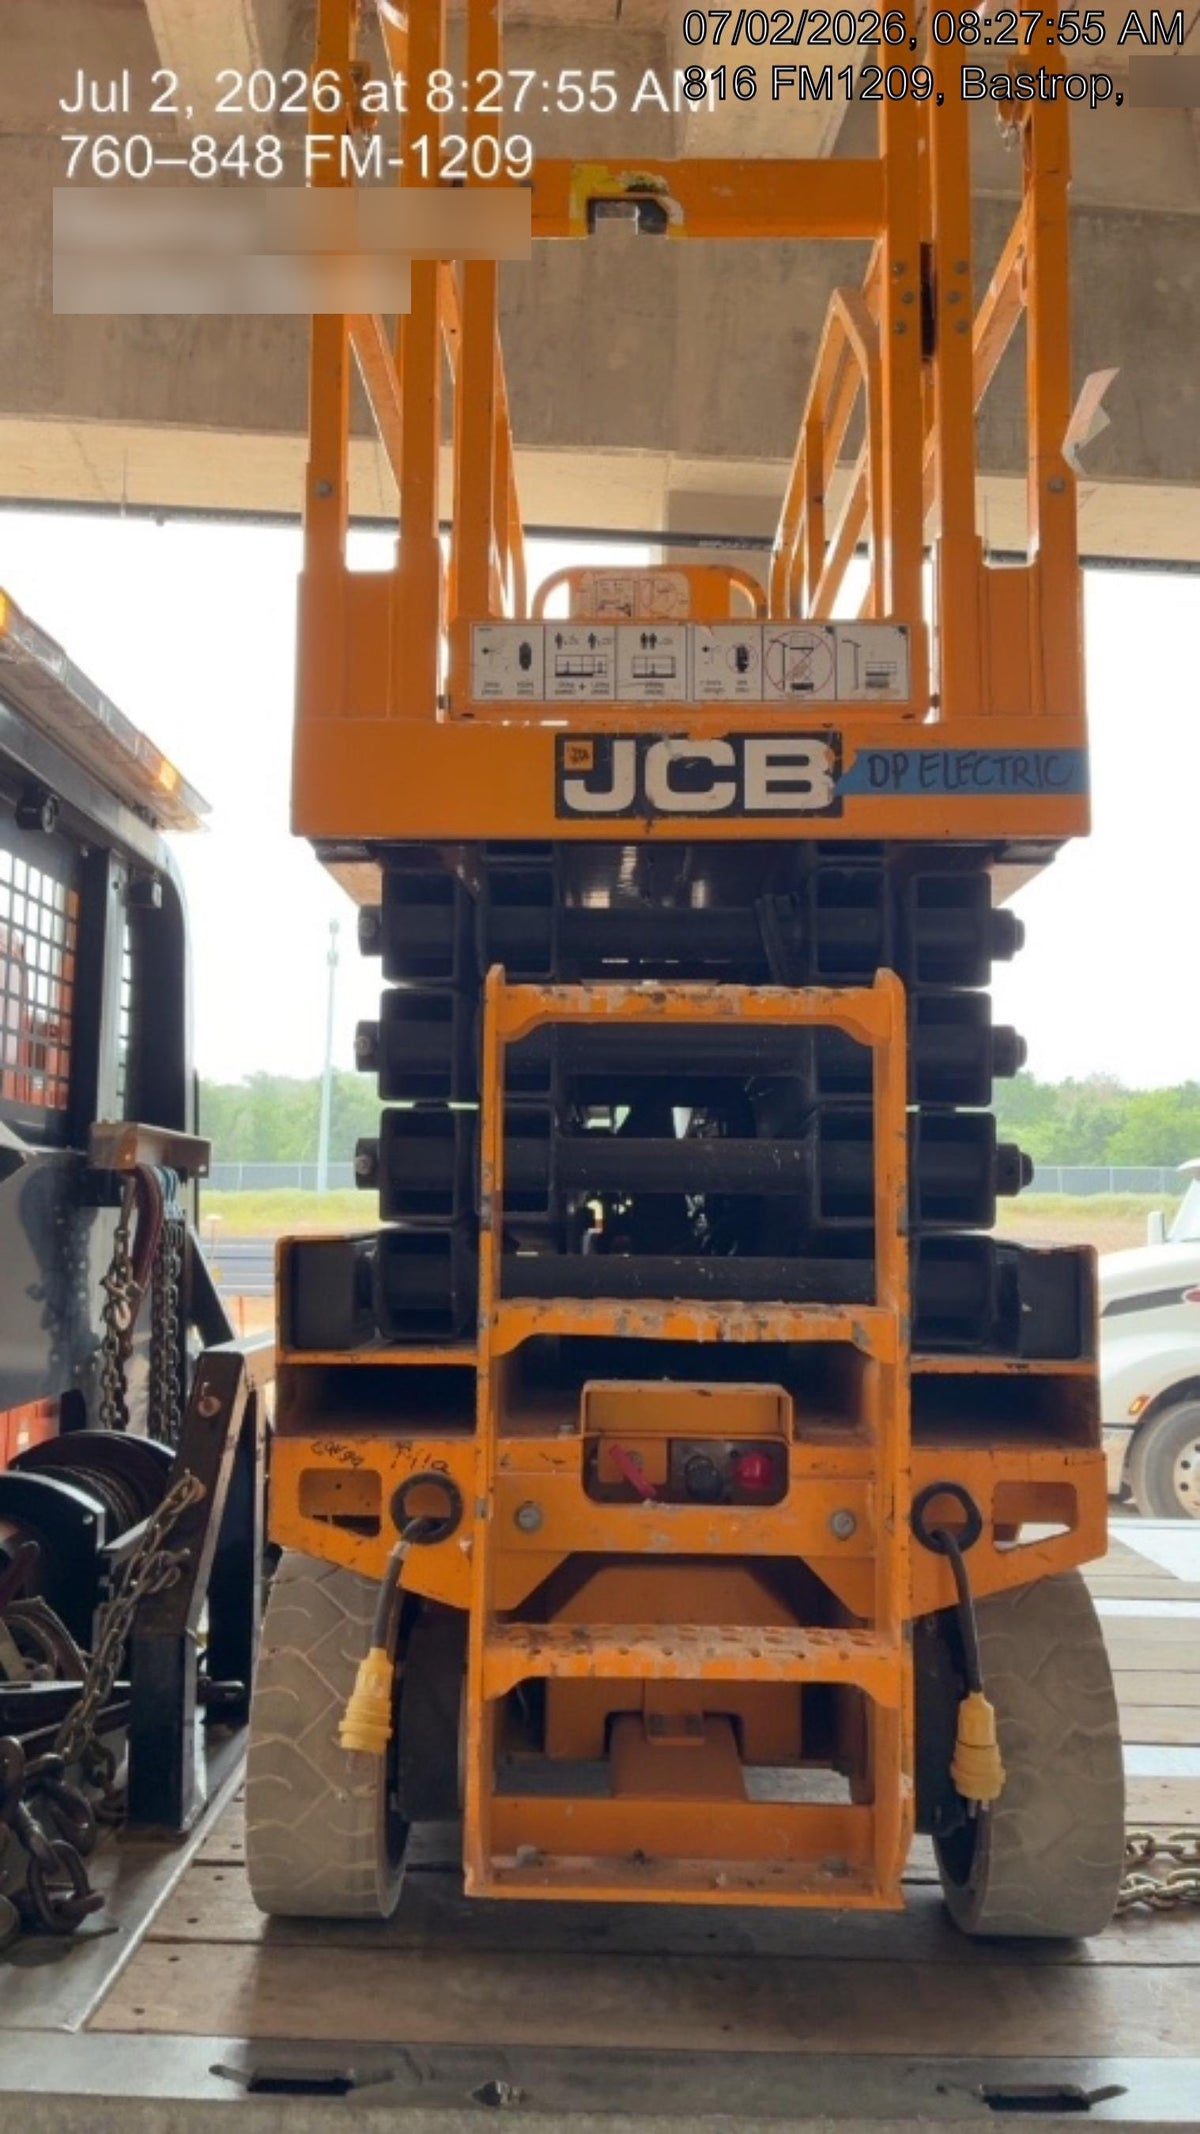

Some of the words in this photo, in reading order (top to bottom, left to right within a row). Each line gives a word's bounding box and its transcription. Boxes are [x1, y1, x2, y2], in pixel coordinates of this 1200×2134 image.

[563, 738, 836, 811] JCB
[868, 752, 909, 788] DP
[920, 750, 1074, 790] ELECTRIC
